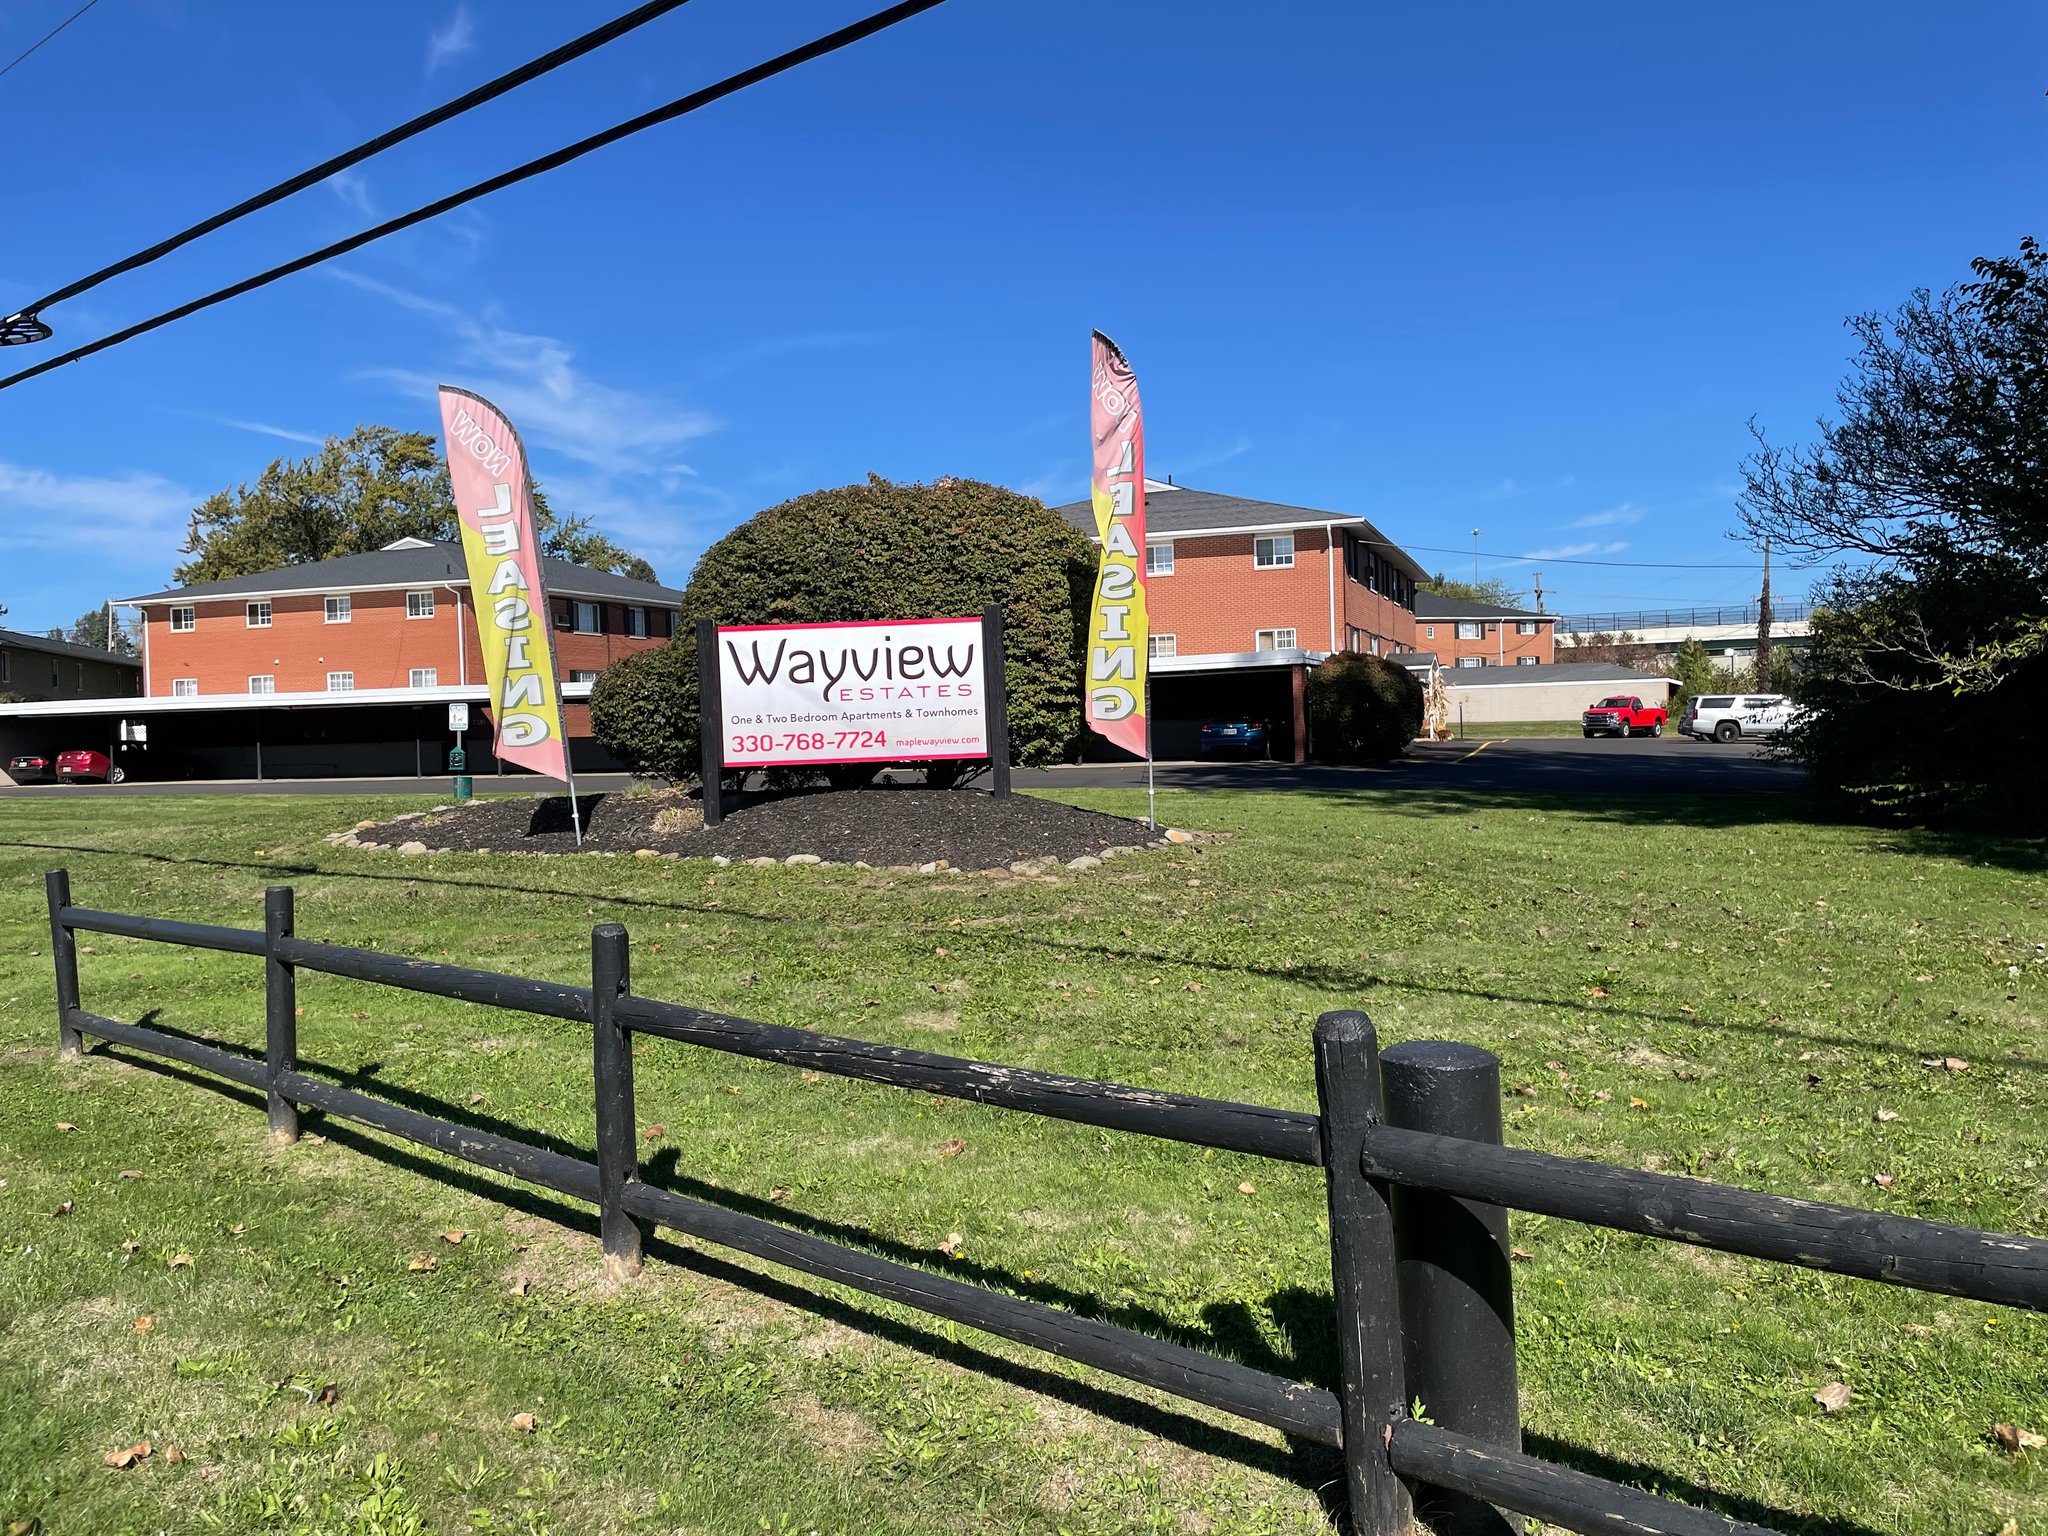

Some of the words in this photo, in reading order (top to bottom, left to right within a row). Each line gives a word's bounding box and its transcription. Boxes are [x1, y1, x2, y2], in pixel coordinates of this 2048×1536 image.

[726, 635, 974, 702] Wayview
[840, 683, 973, 702] ESTATES
[731, 715, 753, 725] One
[755, 714, 764, 724] &
[766, 713, 788, 724] Two
[790, 712, 838, 723] Bedroom
[841, 711, 902, 723] Apartments
[905, 709, 913, 718] &
[916, 707, 979, 718] Townhomes
[732, 730, 887, 753] 330-768-7724
[896, 736, 980, 748] maplewayview.com
